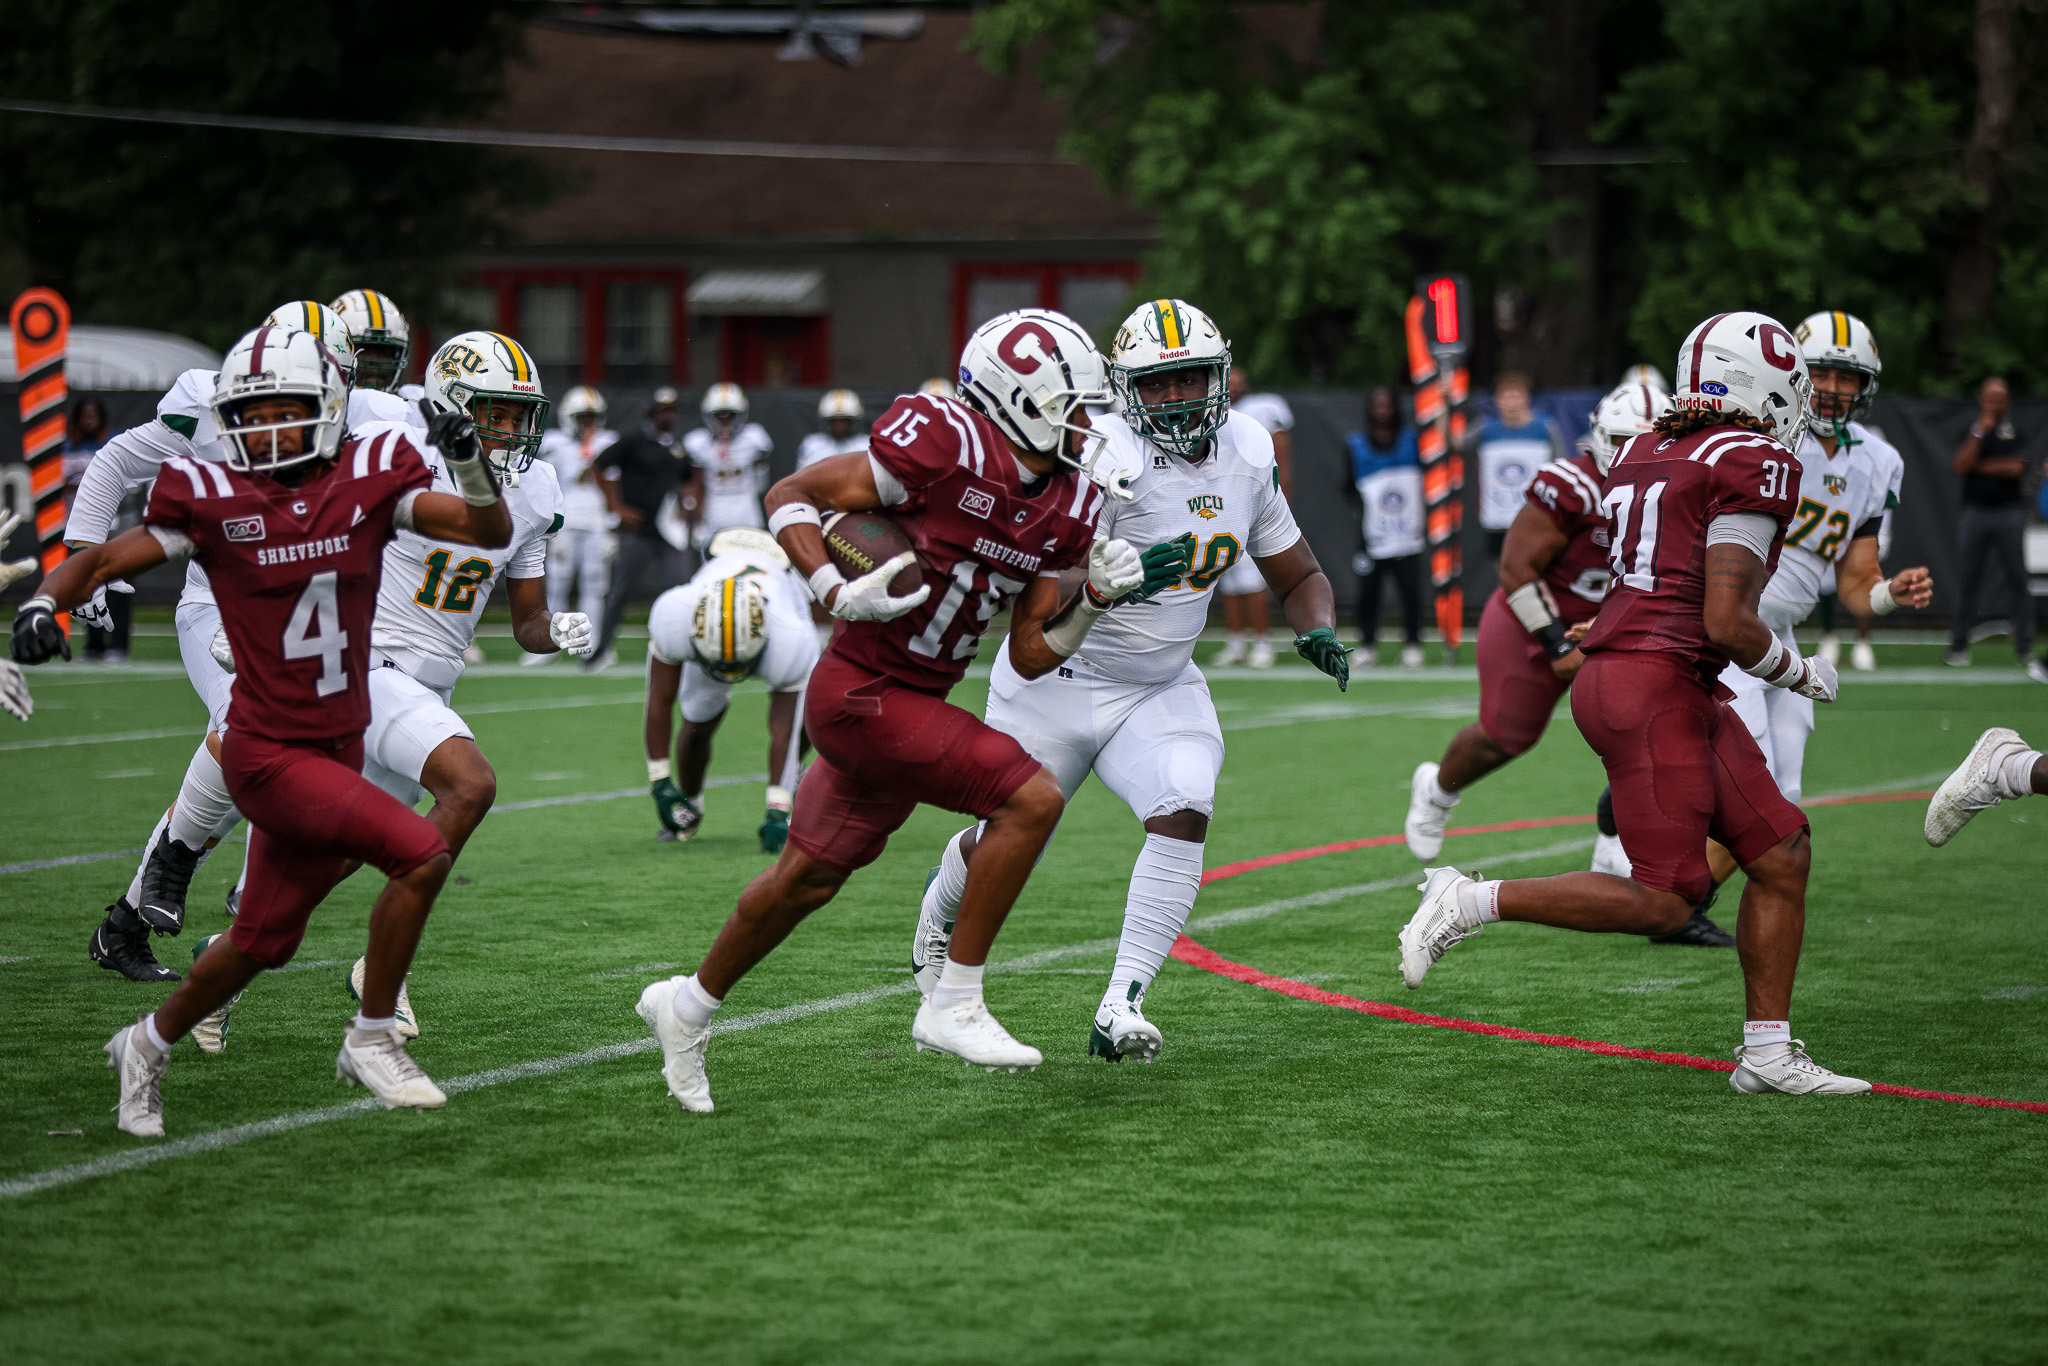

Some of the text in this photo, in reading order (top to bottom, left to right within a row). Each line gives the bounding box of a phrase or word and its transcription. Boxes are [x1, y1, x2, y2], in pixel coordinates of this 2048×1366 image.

[997, 321, 1058, 376] C
[1159, 349, 1190, 360] Riddell
[1759, 323, 1796, 372] C
[512, 382, 536, 393] Riddell
[1703, 383, 1725, 395] SCAC
[1677, 397, 1722, 411] Riddell
[879, 408, 931, 448] 15
[1759, 459, 1790, 501] 31
[292, 501, 307, 515] C
[963, 493, 990, 511] 200
[1186, 494, 1224, 514] WCU
[228, 520, 260, 538] 200
[1014, 511, 1026, 523] C
[1784, 496, 1850, 562] 72
[257, 534, 350, 566] SHREVEPORT
[973, 537, 1042, 572] SHREVEPORT
[413, 547, 495, 614] 12
[907, 560, 1028, 661] 15
[282, 569, 348, 698] 4
[1744, 1022, 1782, 1032] Supreme
